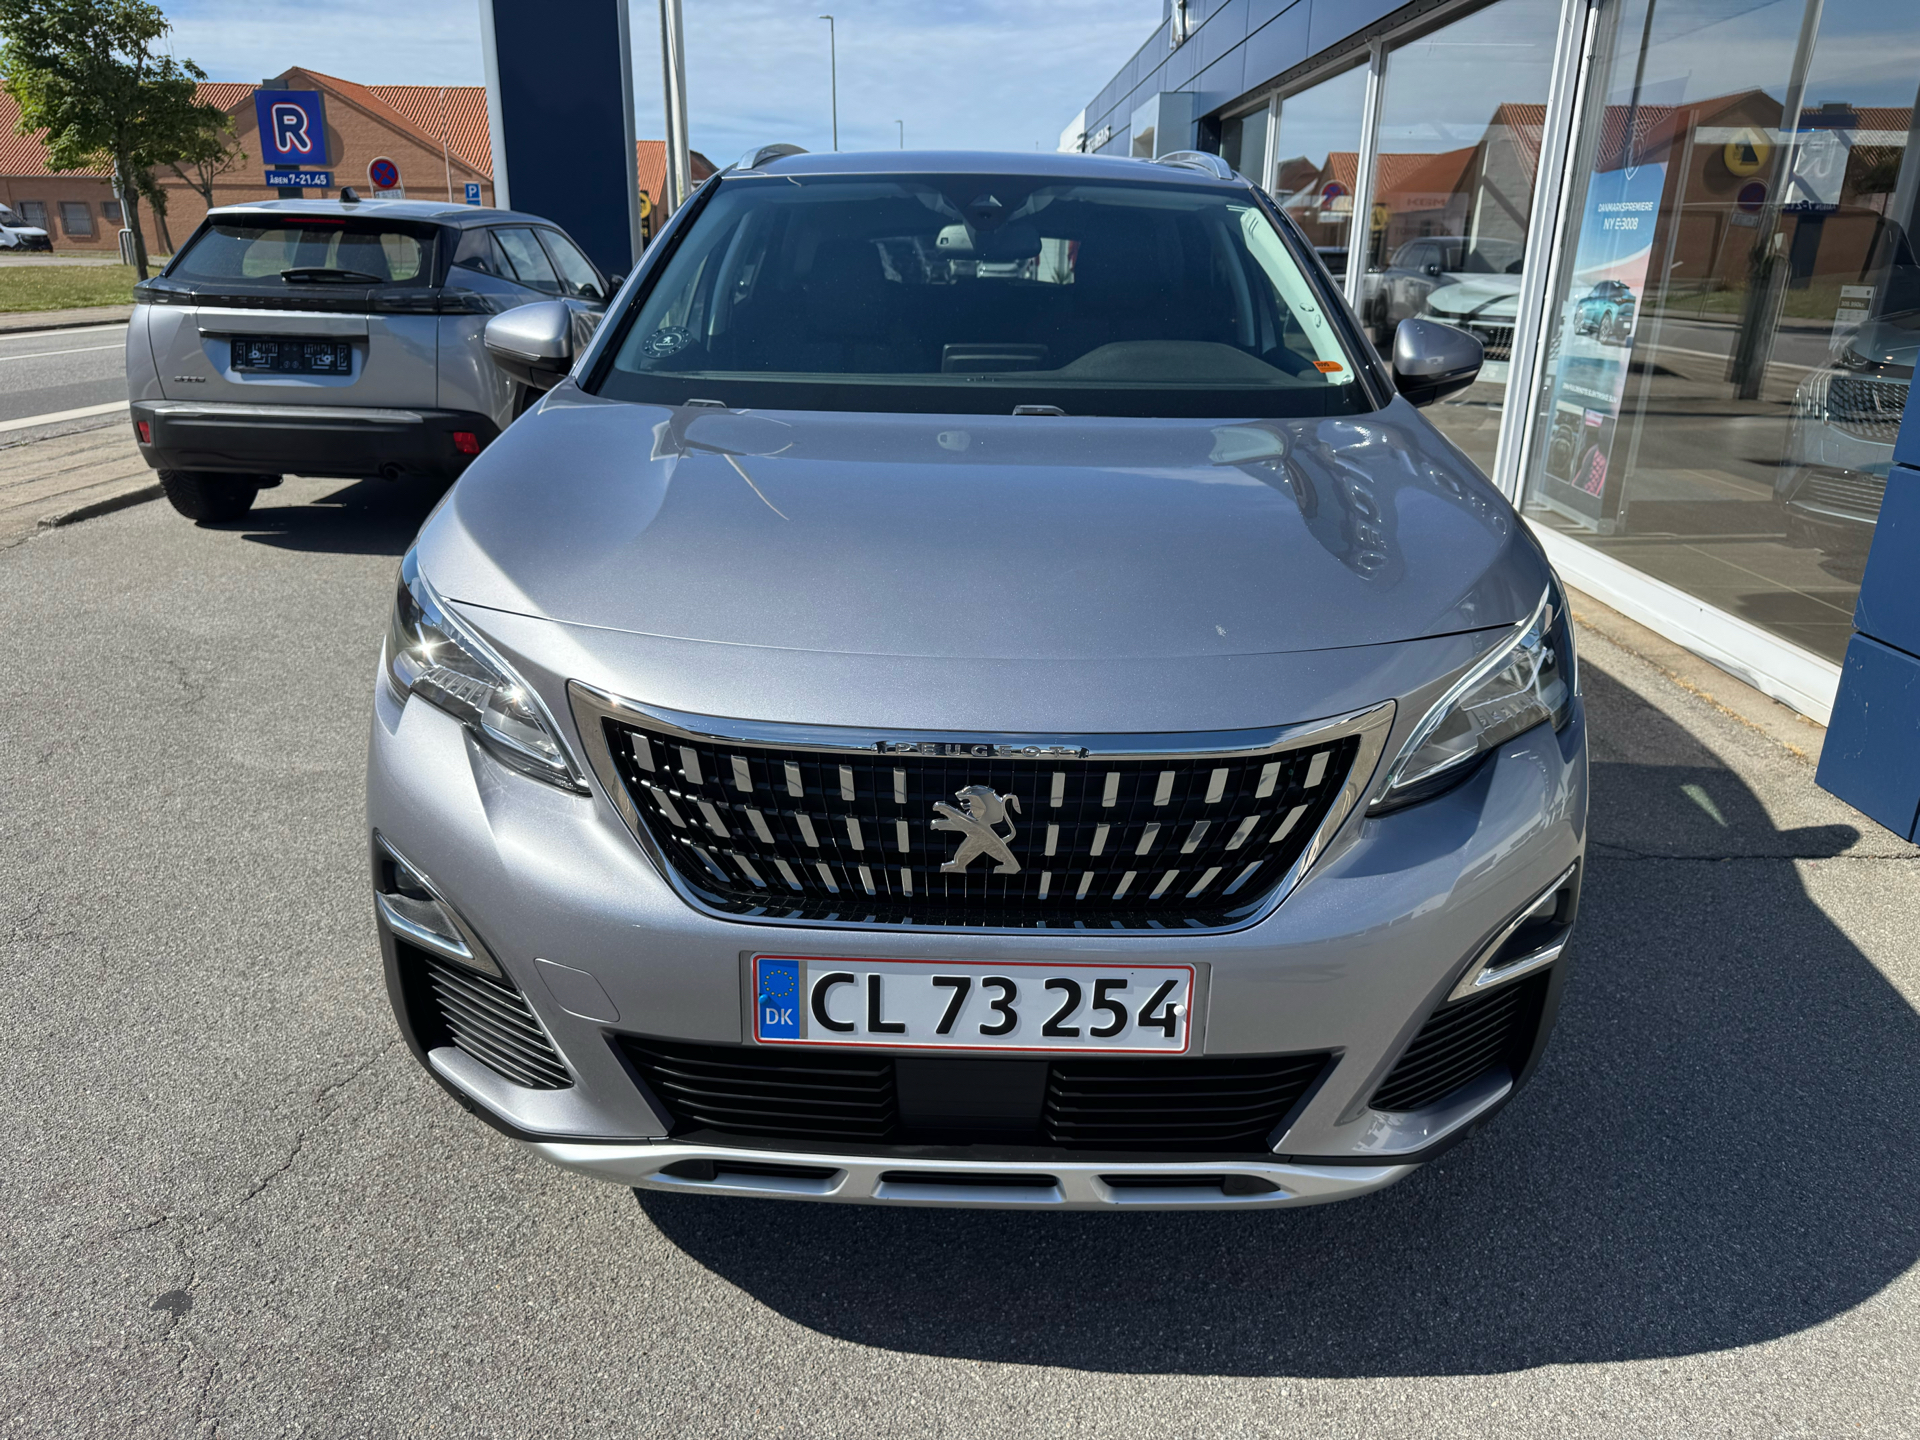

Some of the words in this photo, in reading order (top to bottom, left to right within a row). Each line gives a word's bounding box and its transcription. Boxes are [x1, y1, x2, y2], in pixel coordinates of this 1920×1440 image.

[271, 102, 313, 154] R
[269, 174, 288, 184] ÅBEN
[289, 174, 327, 185] 7-21.45
[468, 185, 477, 197] P
[1598, 202, 1654, 212] DANMARKSPREMIERE
[1603, 217, 1615, 230] NY
[1614, 217, 1639, 230] E-3008
[895, 742, 1065, 757] PEUGEOT
[810, 971, 906, 1033] CL
[932, 975, 1018, 1036] 73
[1042, 977, 1180, 1039] 254
[765, 1008, 794, 1026] DK
